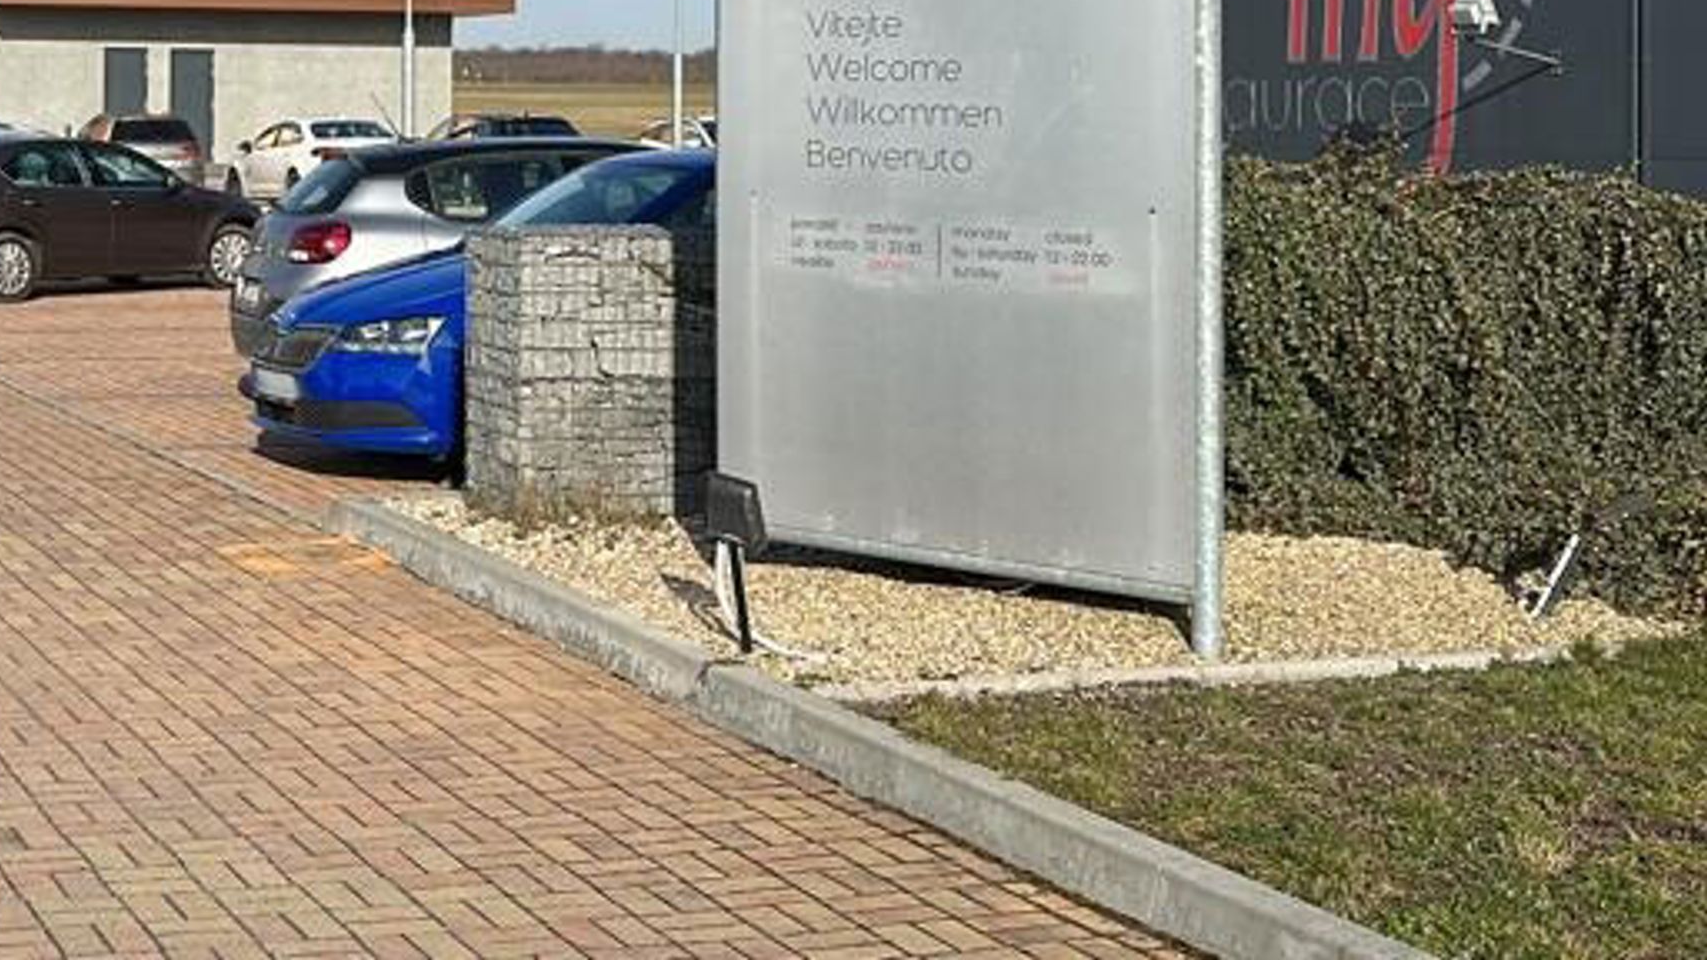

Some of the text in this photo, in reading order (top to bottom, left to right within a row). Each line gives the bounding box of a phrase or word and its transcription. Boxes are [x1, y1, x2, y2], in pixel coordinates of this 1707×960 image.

[806, 53, 962, 83] Welcome
[1223, 76, 1430, 138] aurace
[806, 139, 973, 175] Benvenuto
